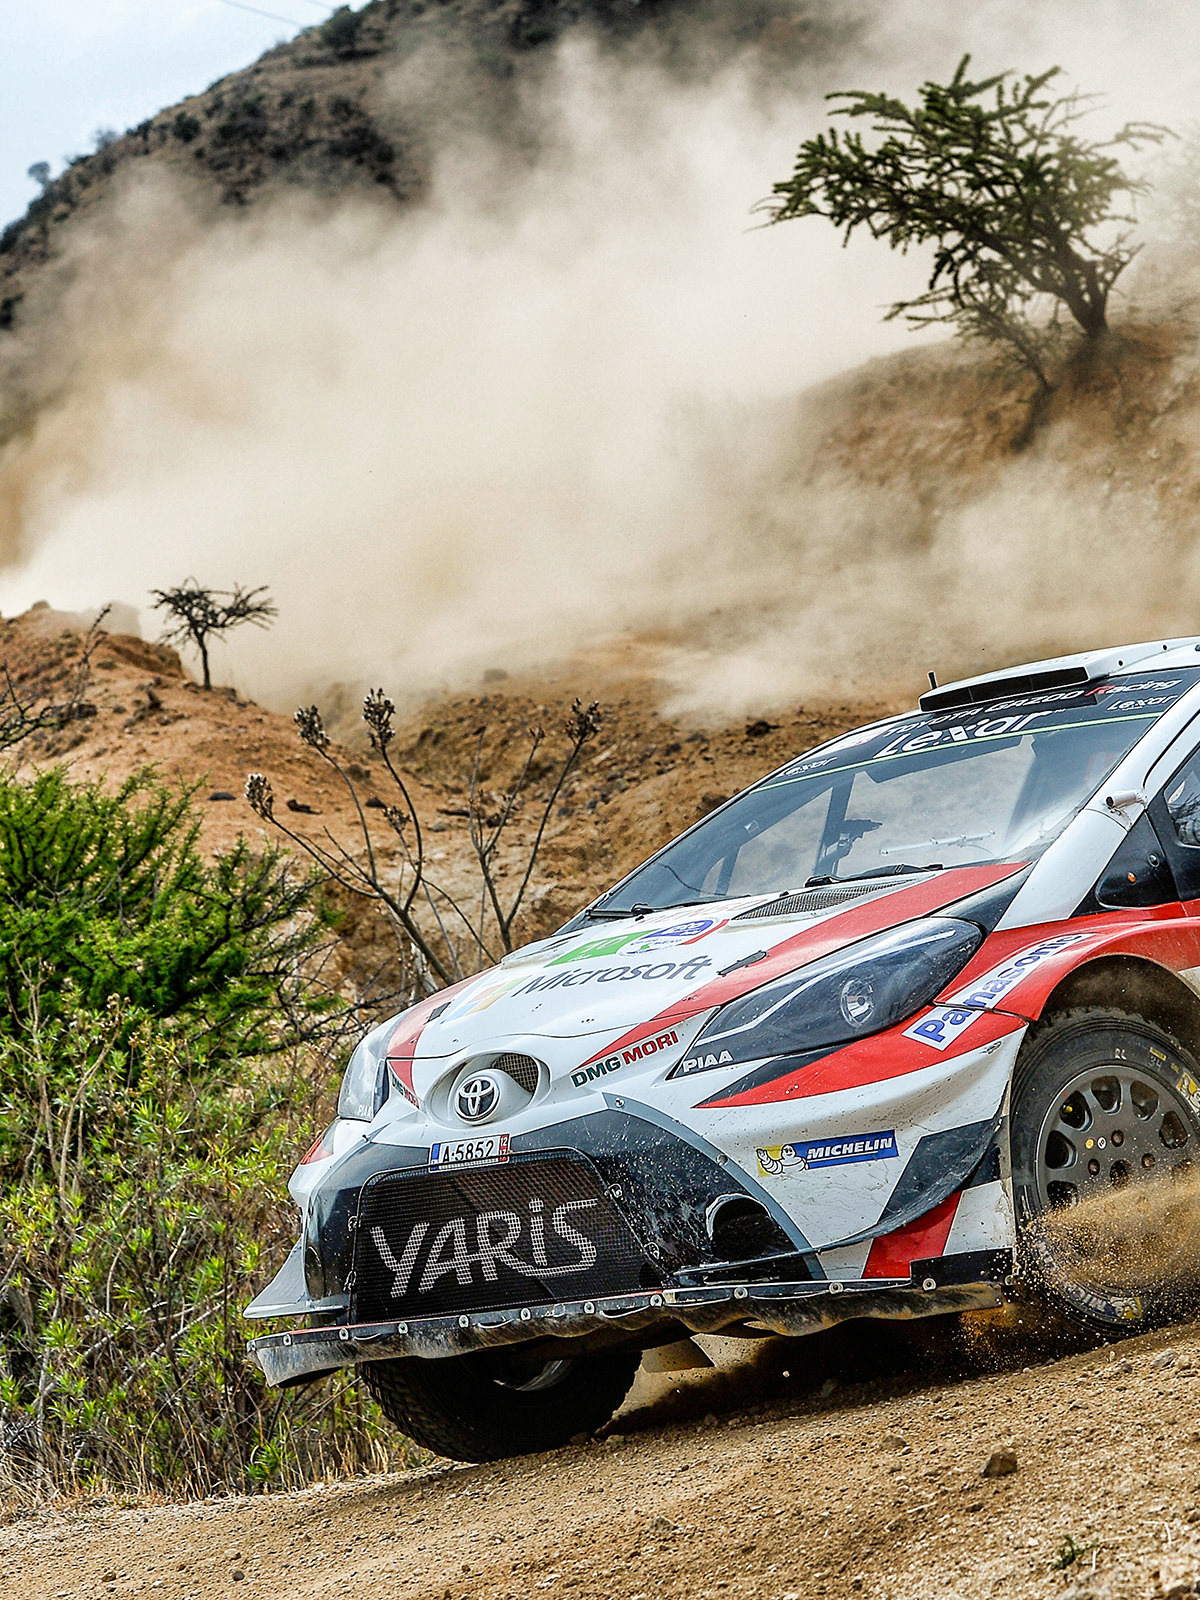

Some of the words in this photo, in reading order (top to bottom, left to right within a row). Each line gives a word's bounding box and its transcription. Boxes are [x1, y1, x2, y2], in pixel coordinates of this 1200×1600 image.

[984, 689, 1086, 714] GAZOO
[1084, 679, 1183, 696] Racing
[1106, 694, 1179, 711] Lexar
[871, 710, 1053, 760] Lexar
[510, 954, 713, 999] Microsoft
[911, 932, 1085, 1044] Panasonic
[570, 1055, 622, 1090] DMG
[622, 1029, 680, 1066] MORI
[682, 1048, 735, 1073] PIAA
[806, 1136, 895, 1159] MICHELIN
